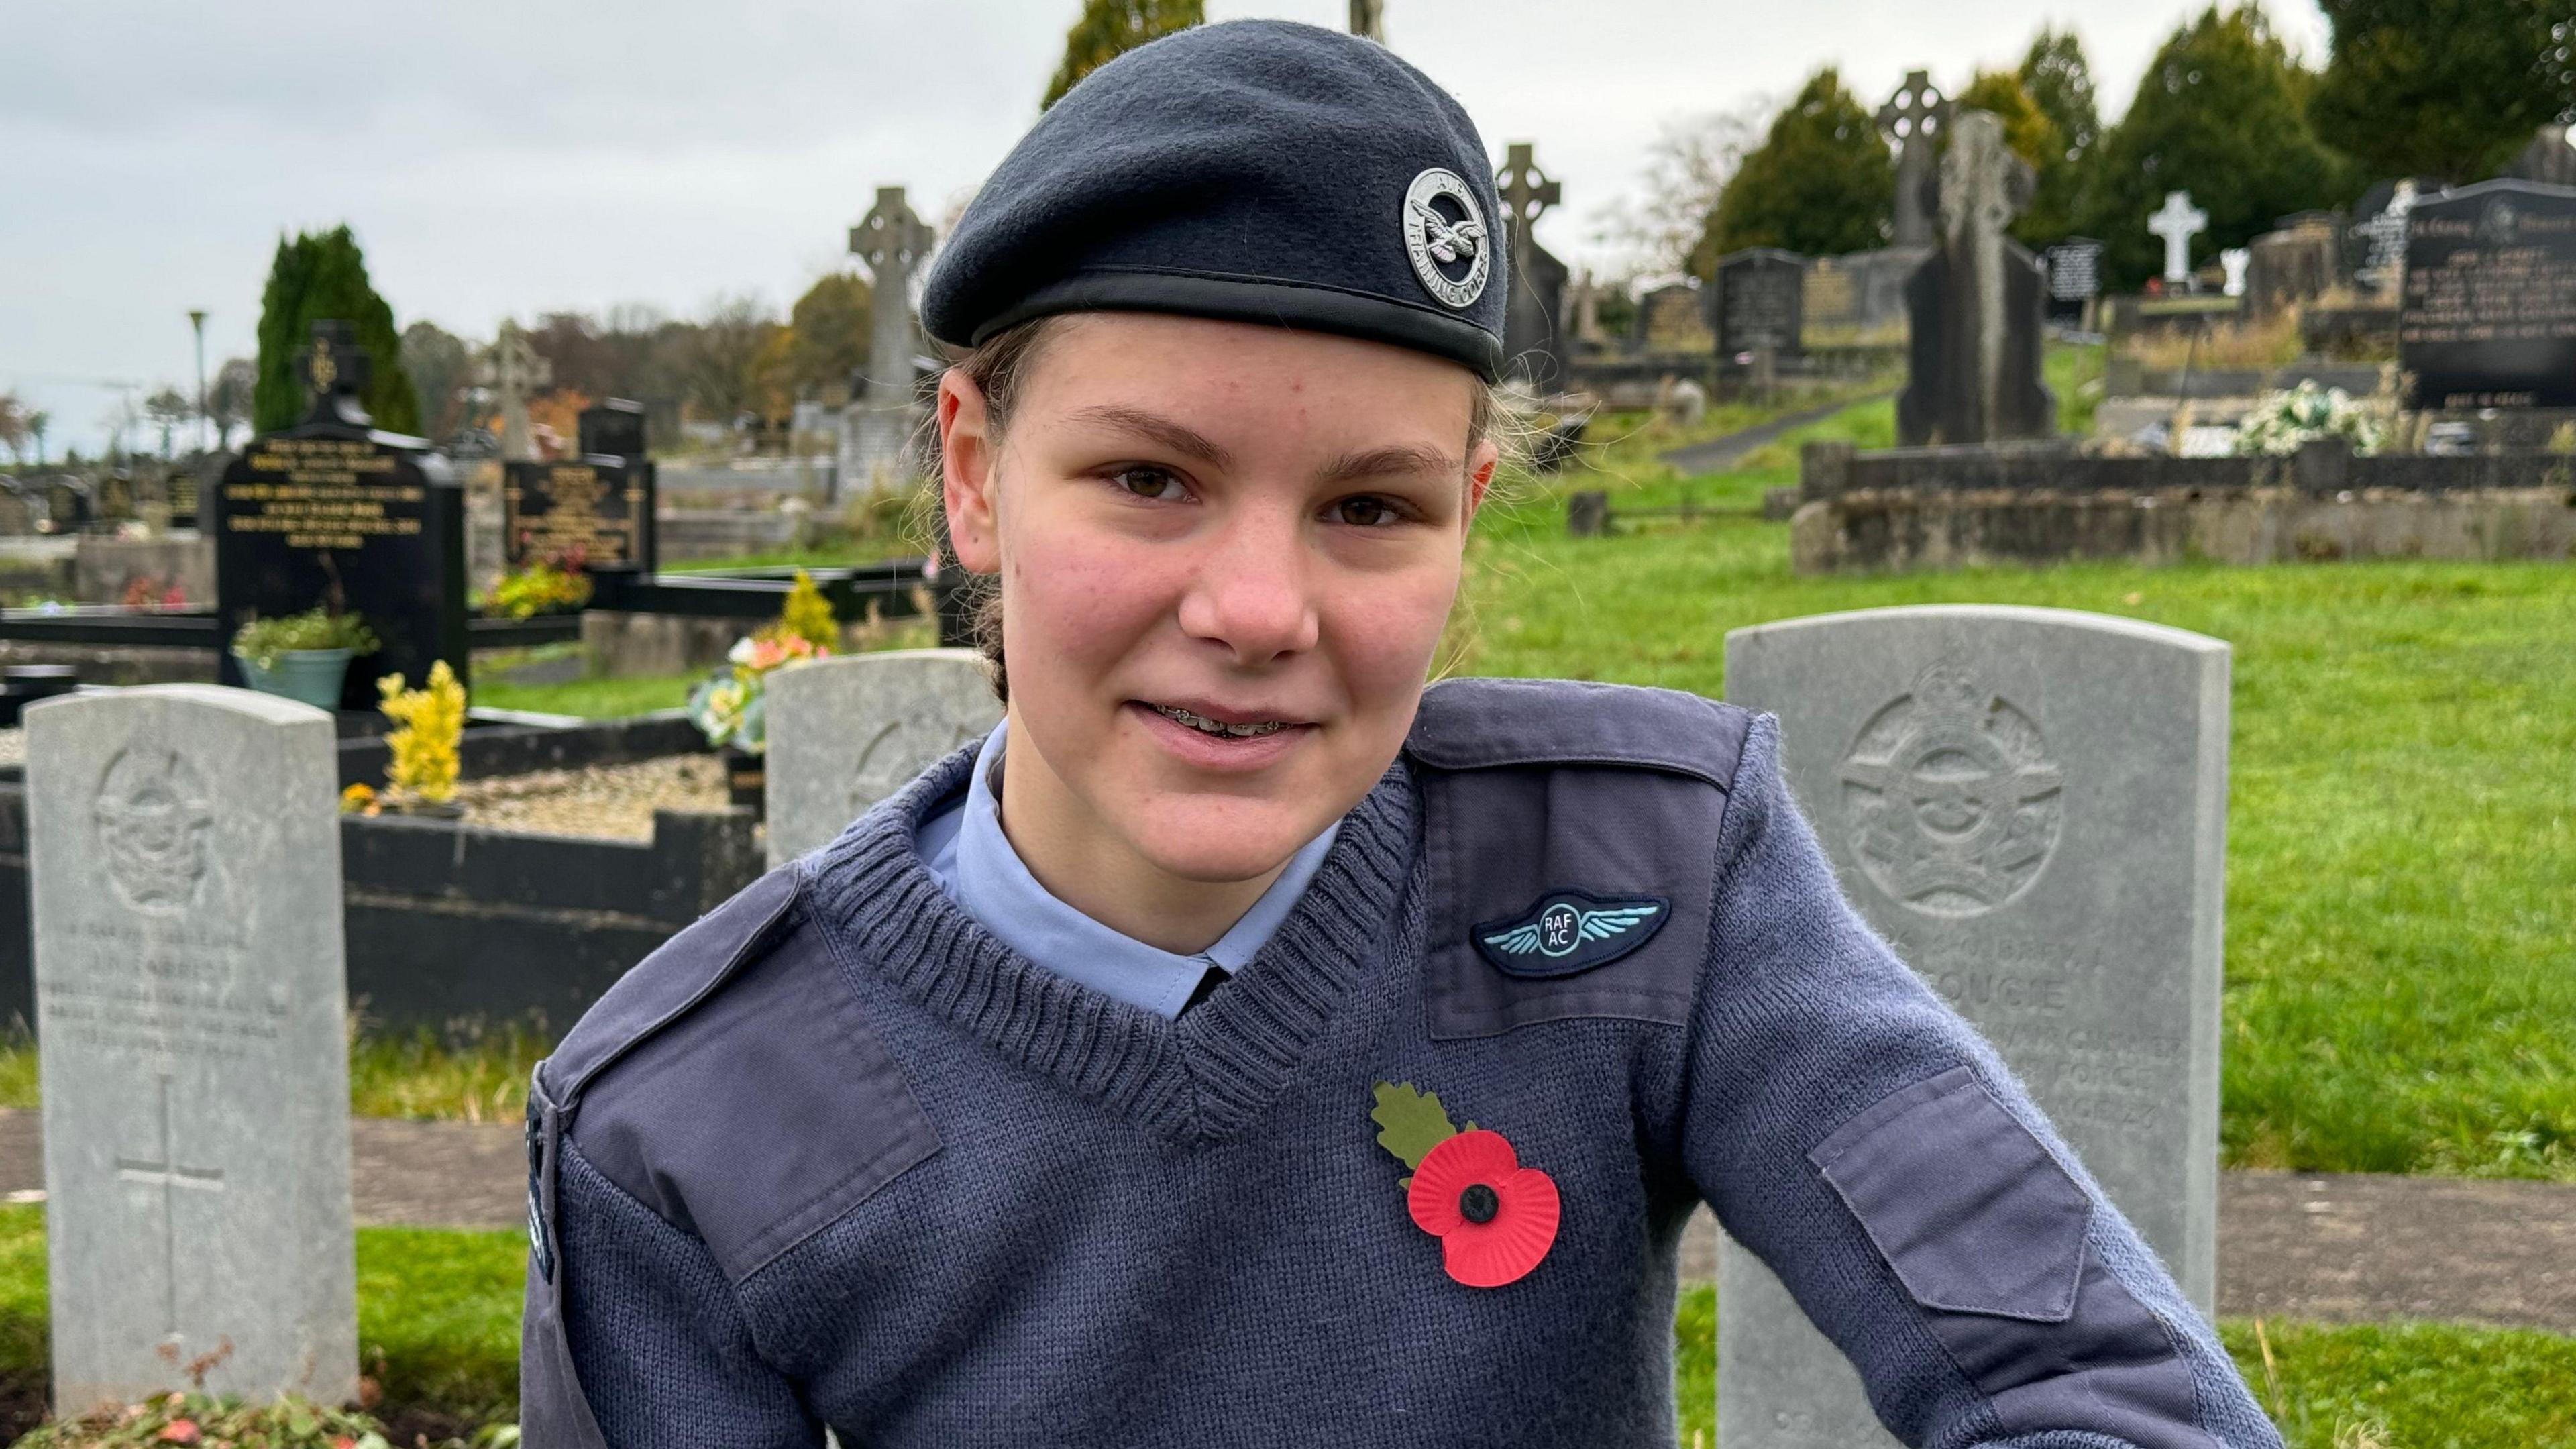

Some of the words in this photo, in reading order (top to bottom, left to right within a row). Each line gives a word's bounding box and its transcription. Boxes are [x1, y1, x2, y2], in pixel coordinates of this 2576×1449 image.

[1408, 222, 1456, 304] TRAINING
[1459, 252, 1488, 305] CORPS
[1544, 913, 1572, 932] RAF
[1548, 930, 1568, 947] AC
[1937, 971, 2065, 1010] OUGIE
